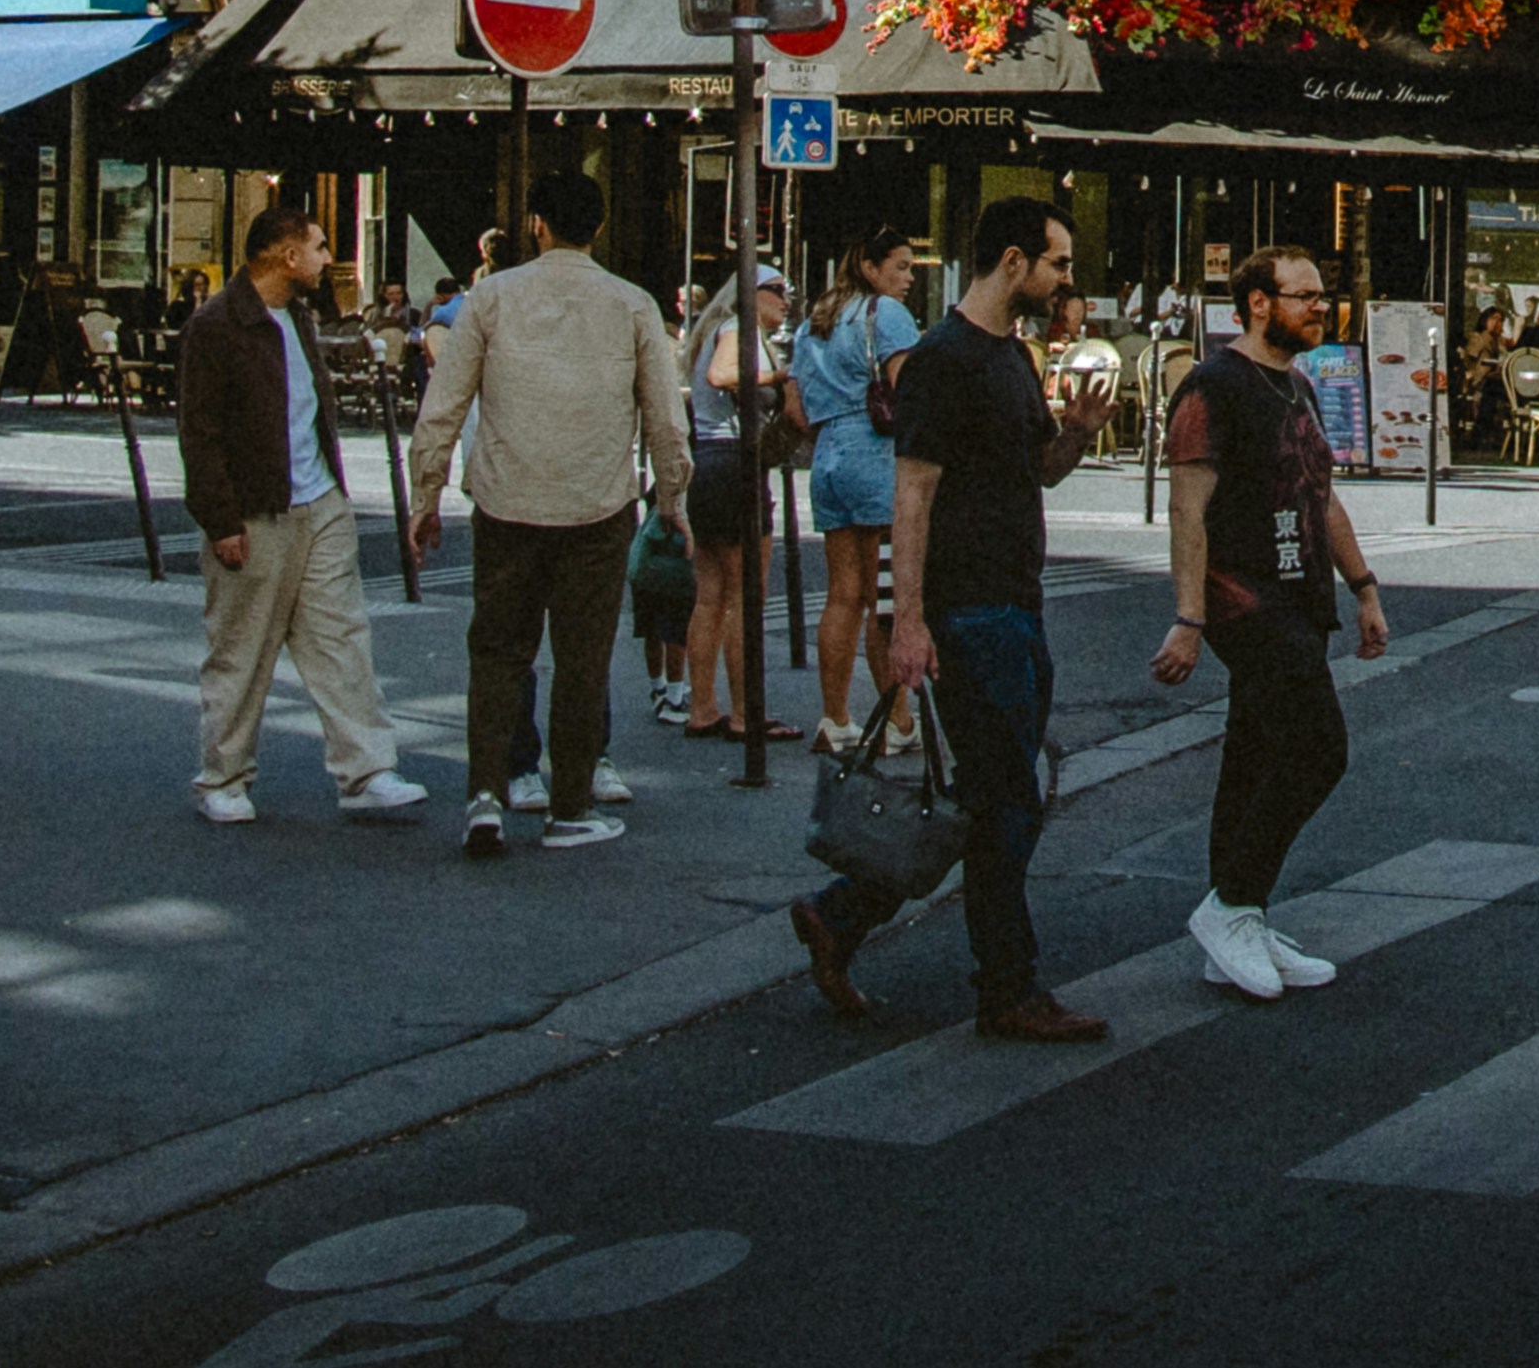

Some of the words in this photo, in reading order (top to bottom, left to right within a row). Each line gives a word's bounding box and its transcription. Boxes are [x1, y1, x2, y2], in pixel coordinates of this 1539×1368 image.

[788, 64, 819, 74] SAUF
[271, 78, 352, 97] BRASSERIE
[668, 76, 734, 96] RESTAU
[1303, 77, 1330, 100] Le
[1333, 80, 1384, 102] Saint
[891, 107, 1015, 126] EMPORTER
[1273, 509, 1303, 572] 東京
